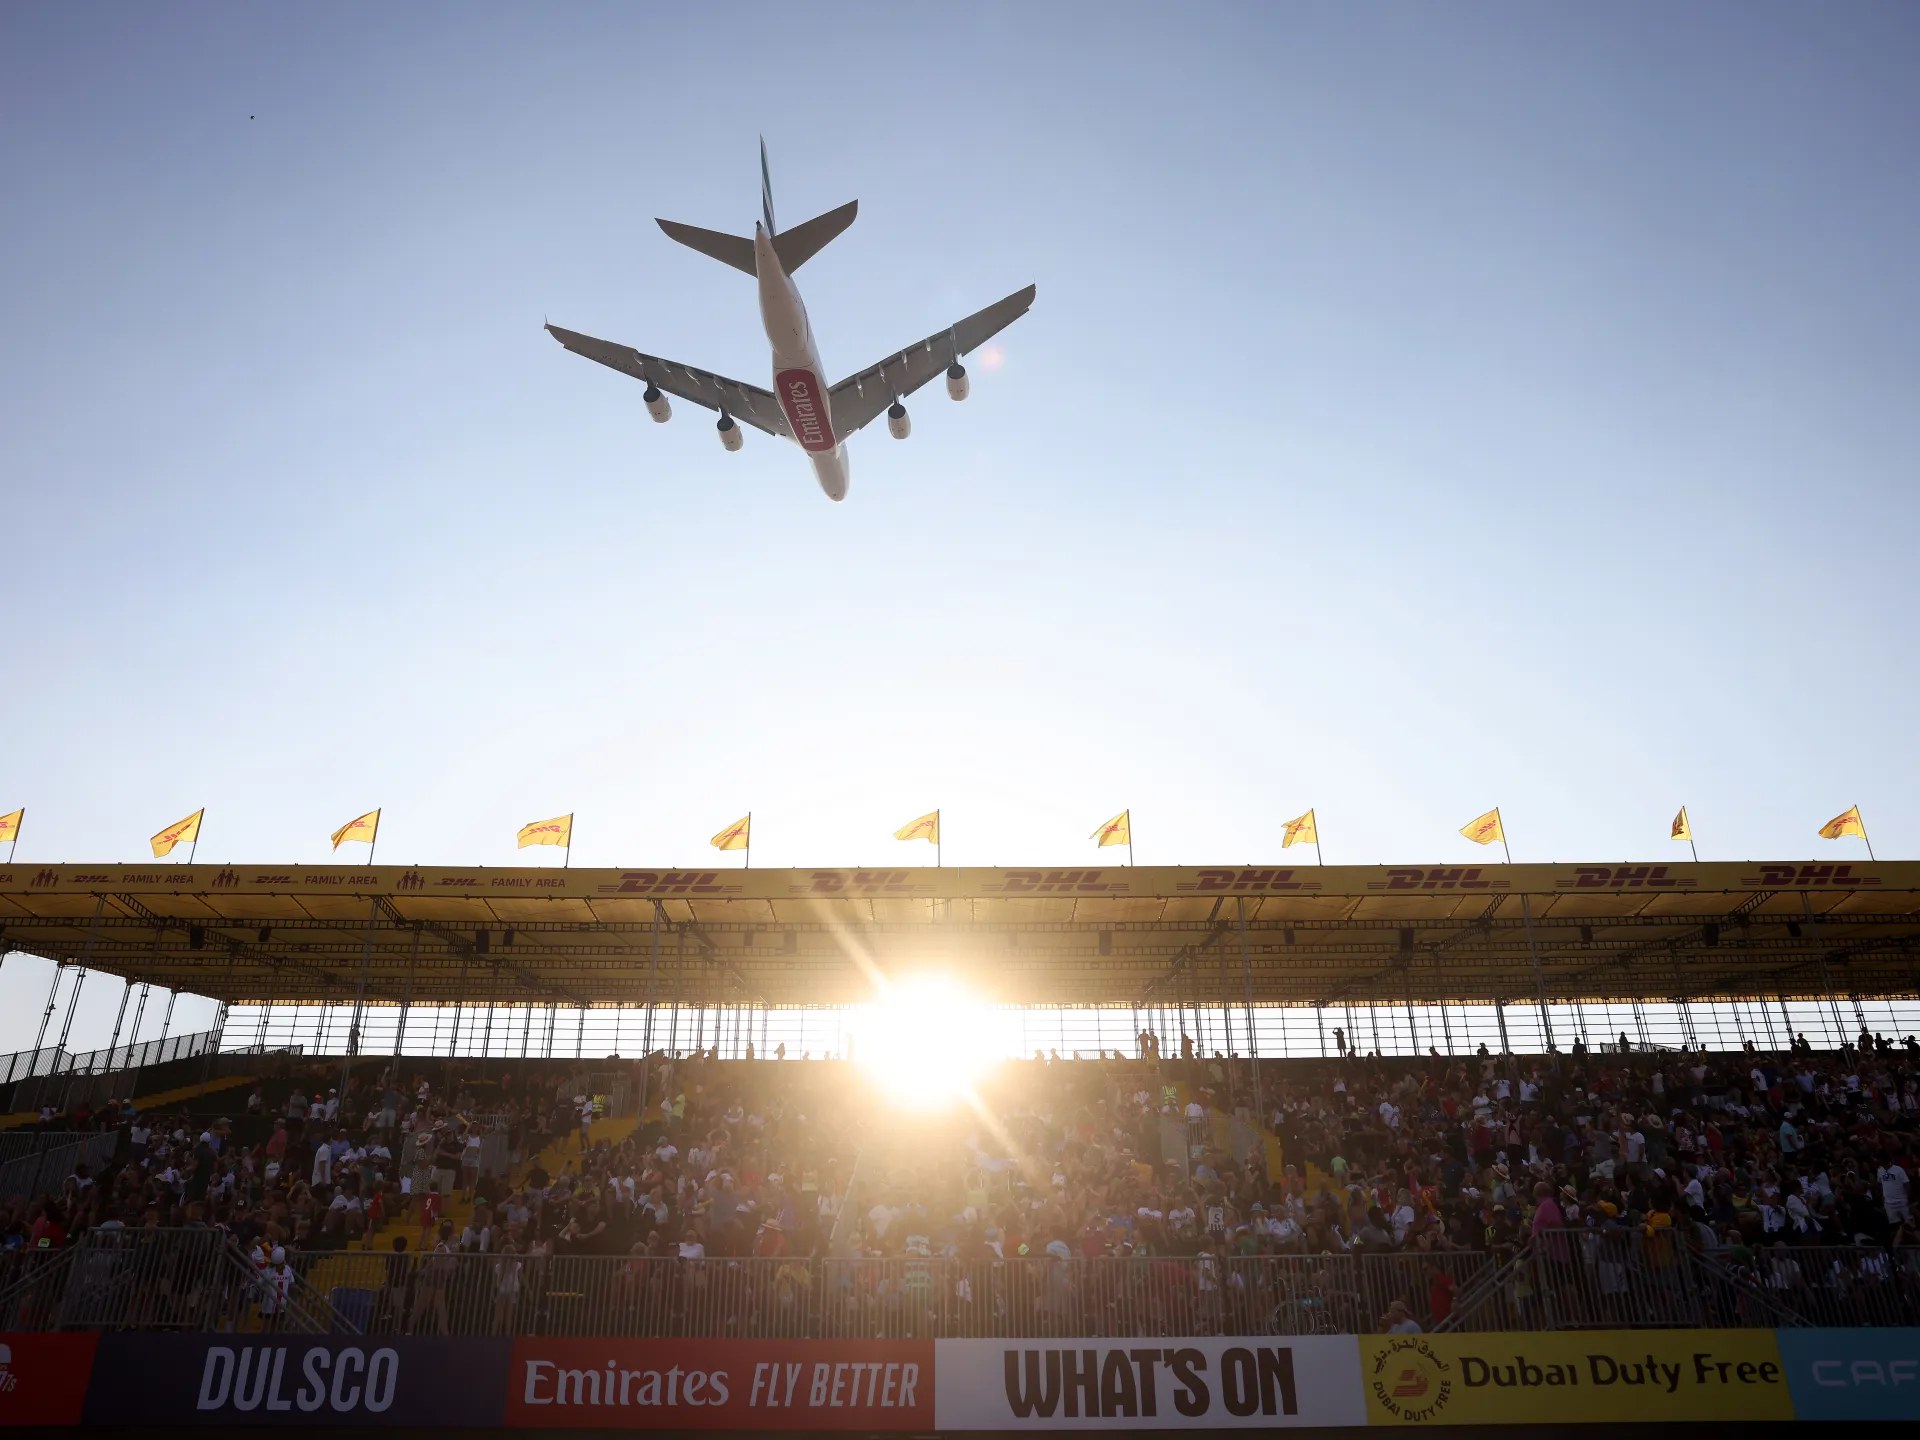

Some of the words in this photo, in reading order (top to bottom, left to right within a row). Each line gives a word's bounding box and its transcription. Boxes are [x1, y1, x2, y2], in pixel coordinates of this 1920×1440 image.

[789, 380, 825, 444] Emirates
[122, 874, 161, 884] FAMILY
[164, 874, 194, 884] AREA
[305, 875, 345, 885] FAMILY
[347, 876, 378, 885] AREA
[491, 878, 532, 887] FAMILY
[535, 878, 566, 888] AREA
[616, 872, 723, 893] DHL
[810, 871, 914, 892] DHL
[1003, 871, 1110, 891] DHL
[1195, 870, 1302, 890] DHL
[1385, 869, 1494, 889] DHL
[1573, 867, 1678, 887] DHL
[1758, 865, 1865, 886] DHL
[196, 1346, 400, 1413] DULSCO
[524, 1359, 730, 1407] Emirates
[749, 1362, 803, 1407] FLY
[809, 1362, 920, 1407] BETTER
[1004, 1348, 1211, 1418] WHAT'S
[1220, 1347, 1299, 1417] ON
[1587, 1354, 1681, 1392] Duty
[1693, 1353, 1780, 1384] Free
[1373, 1381, 1401, 1416] DUBAI
[1404, 1405, 1436, 1422] DUTY
[1435, 1380, 1451, 1409] FREE
